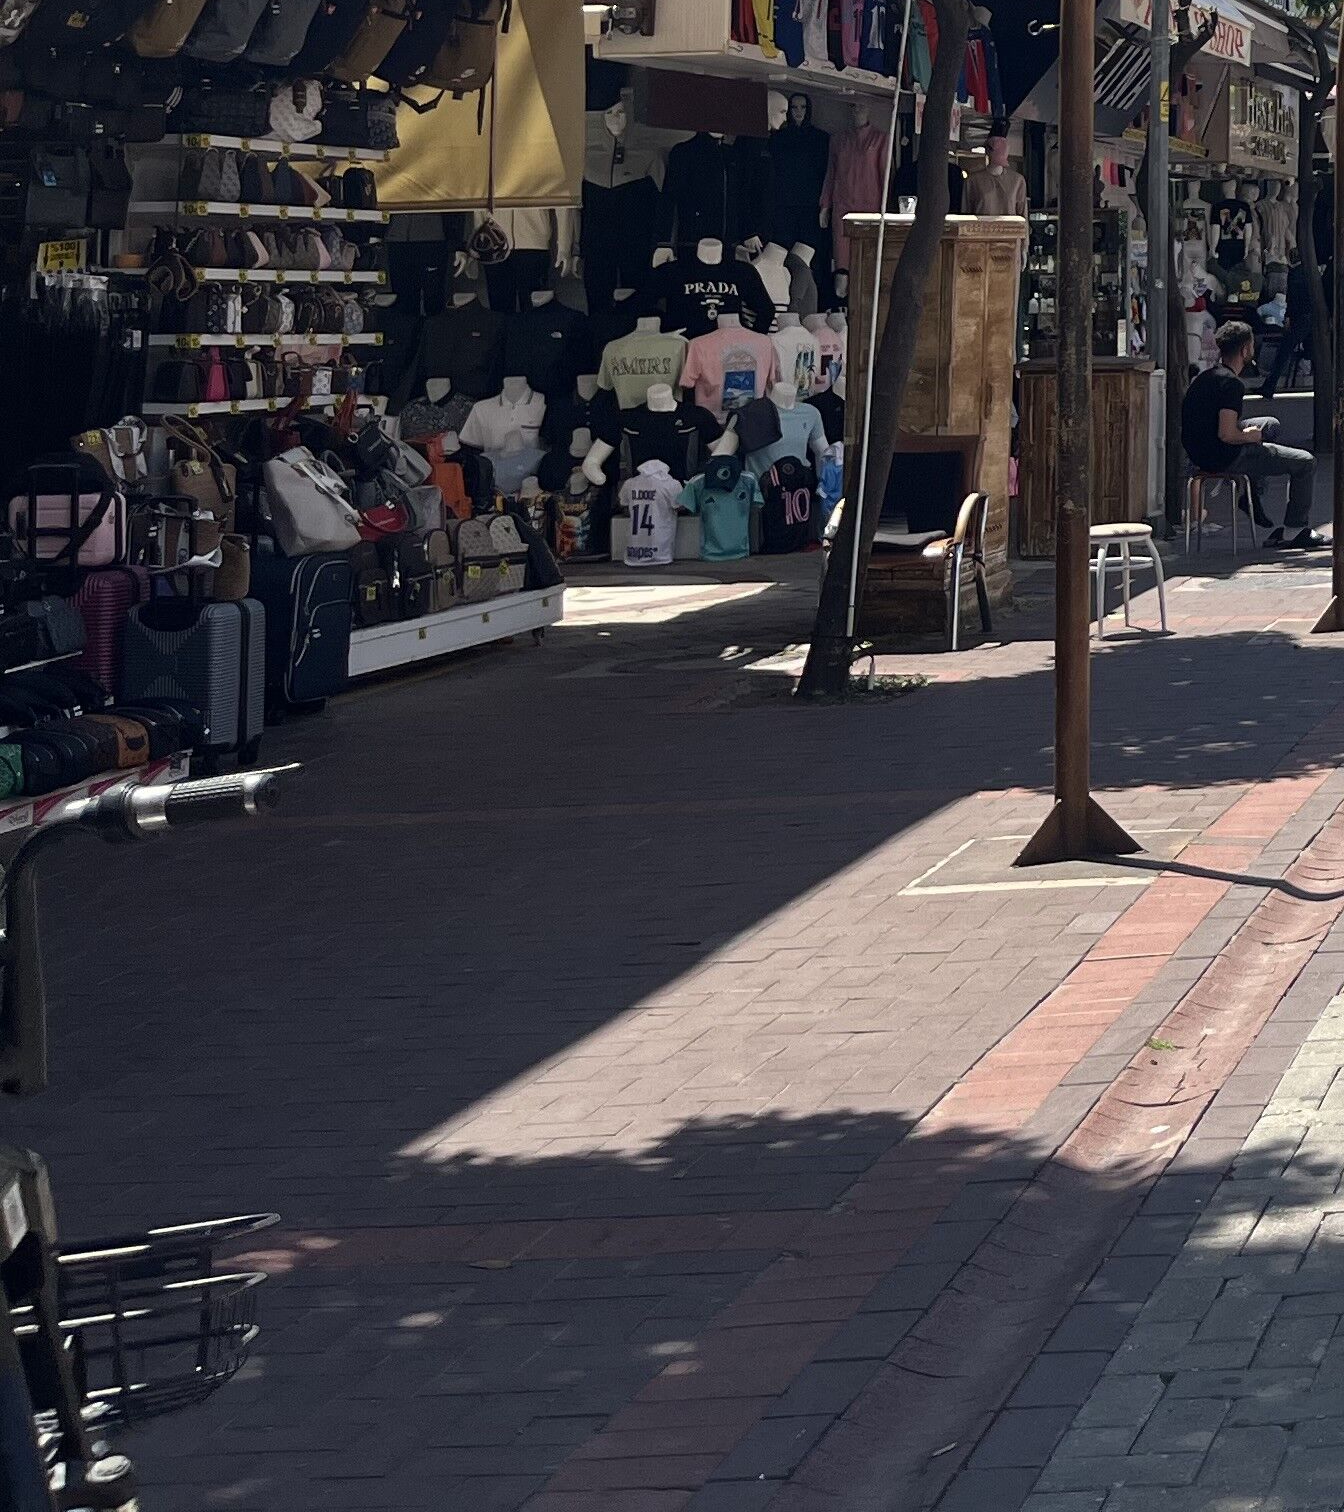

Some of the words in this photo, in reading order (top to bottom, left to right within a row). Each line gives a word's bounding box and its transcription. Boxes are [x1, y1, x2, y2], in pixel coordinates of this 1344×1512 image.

[684, 281, 739, 296] PRADA
[632, 503, 655, 536] 14
[781, 487, 811, 526] 10
